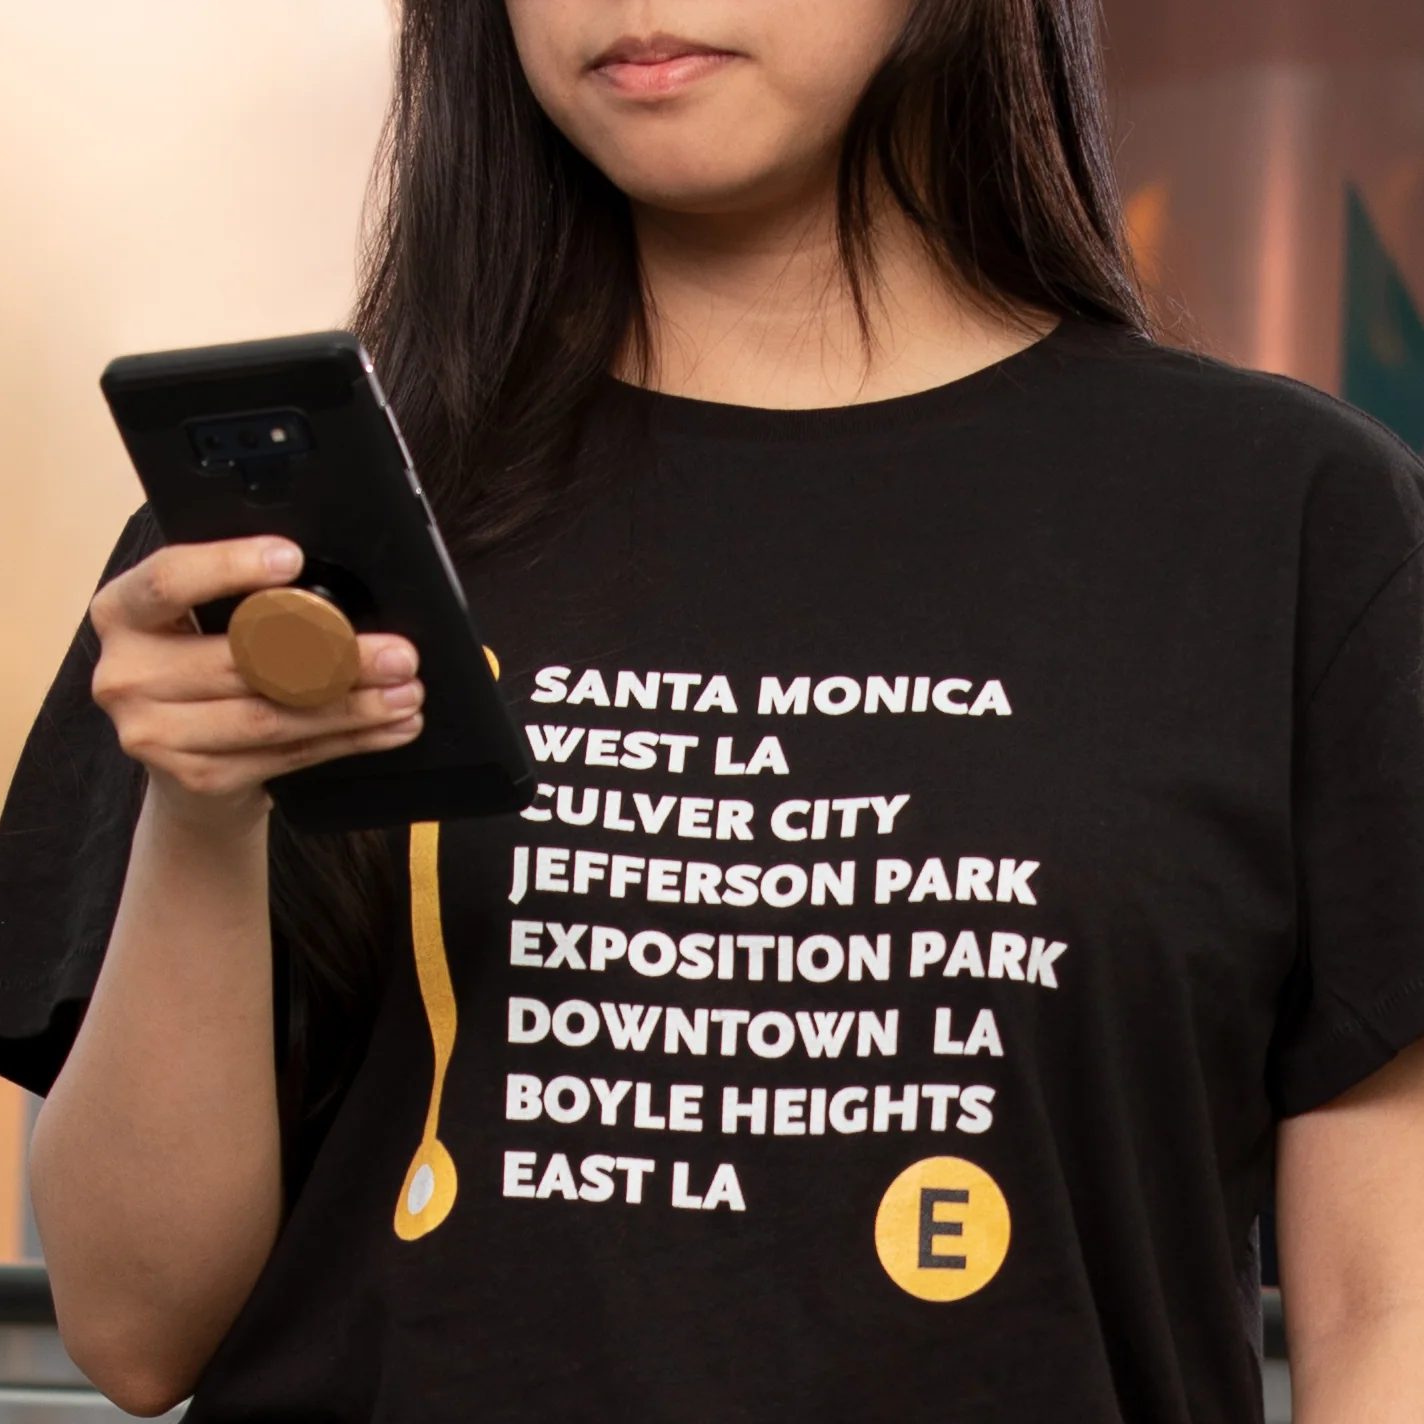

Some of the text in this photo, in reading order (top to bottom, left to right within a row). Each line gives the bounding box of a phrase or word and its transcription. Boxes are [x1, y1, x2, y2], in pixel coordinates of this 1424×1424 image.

[530, 665, 1013, 717] SANTA MONICA
[524, 724, 790, 776] WEST LA
[519, 782, 911, 842] CULVER CITY
[507, 846, 1041, 909] JEFFERSON PARK
[509, 919, 1068, 989] EXPOSITION PARK
[507, 996, 1004, 1059] DOWNTOWN LA
[505, 1073, 996, 1136] BOYLE HEIGHTS
[502, 1150, 747, 1212] EAST LA
[917, 1187, 970, 1270] E
